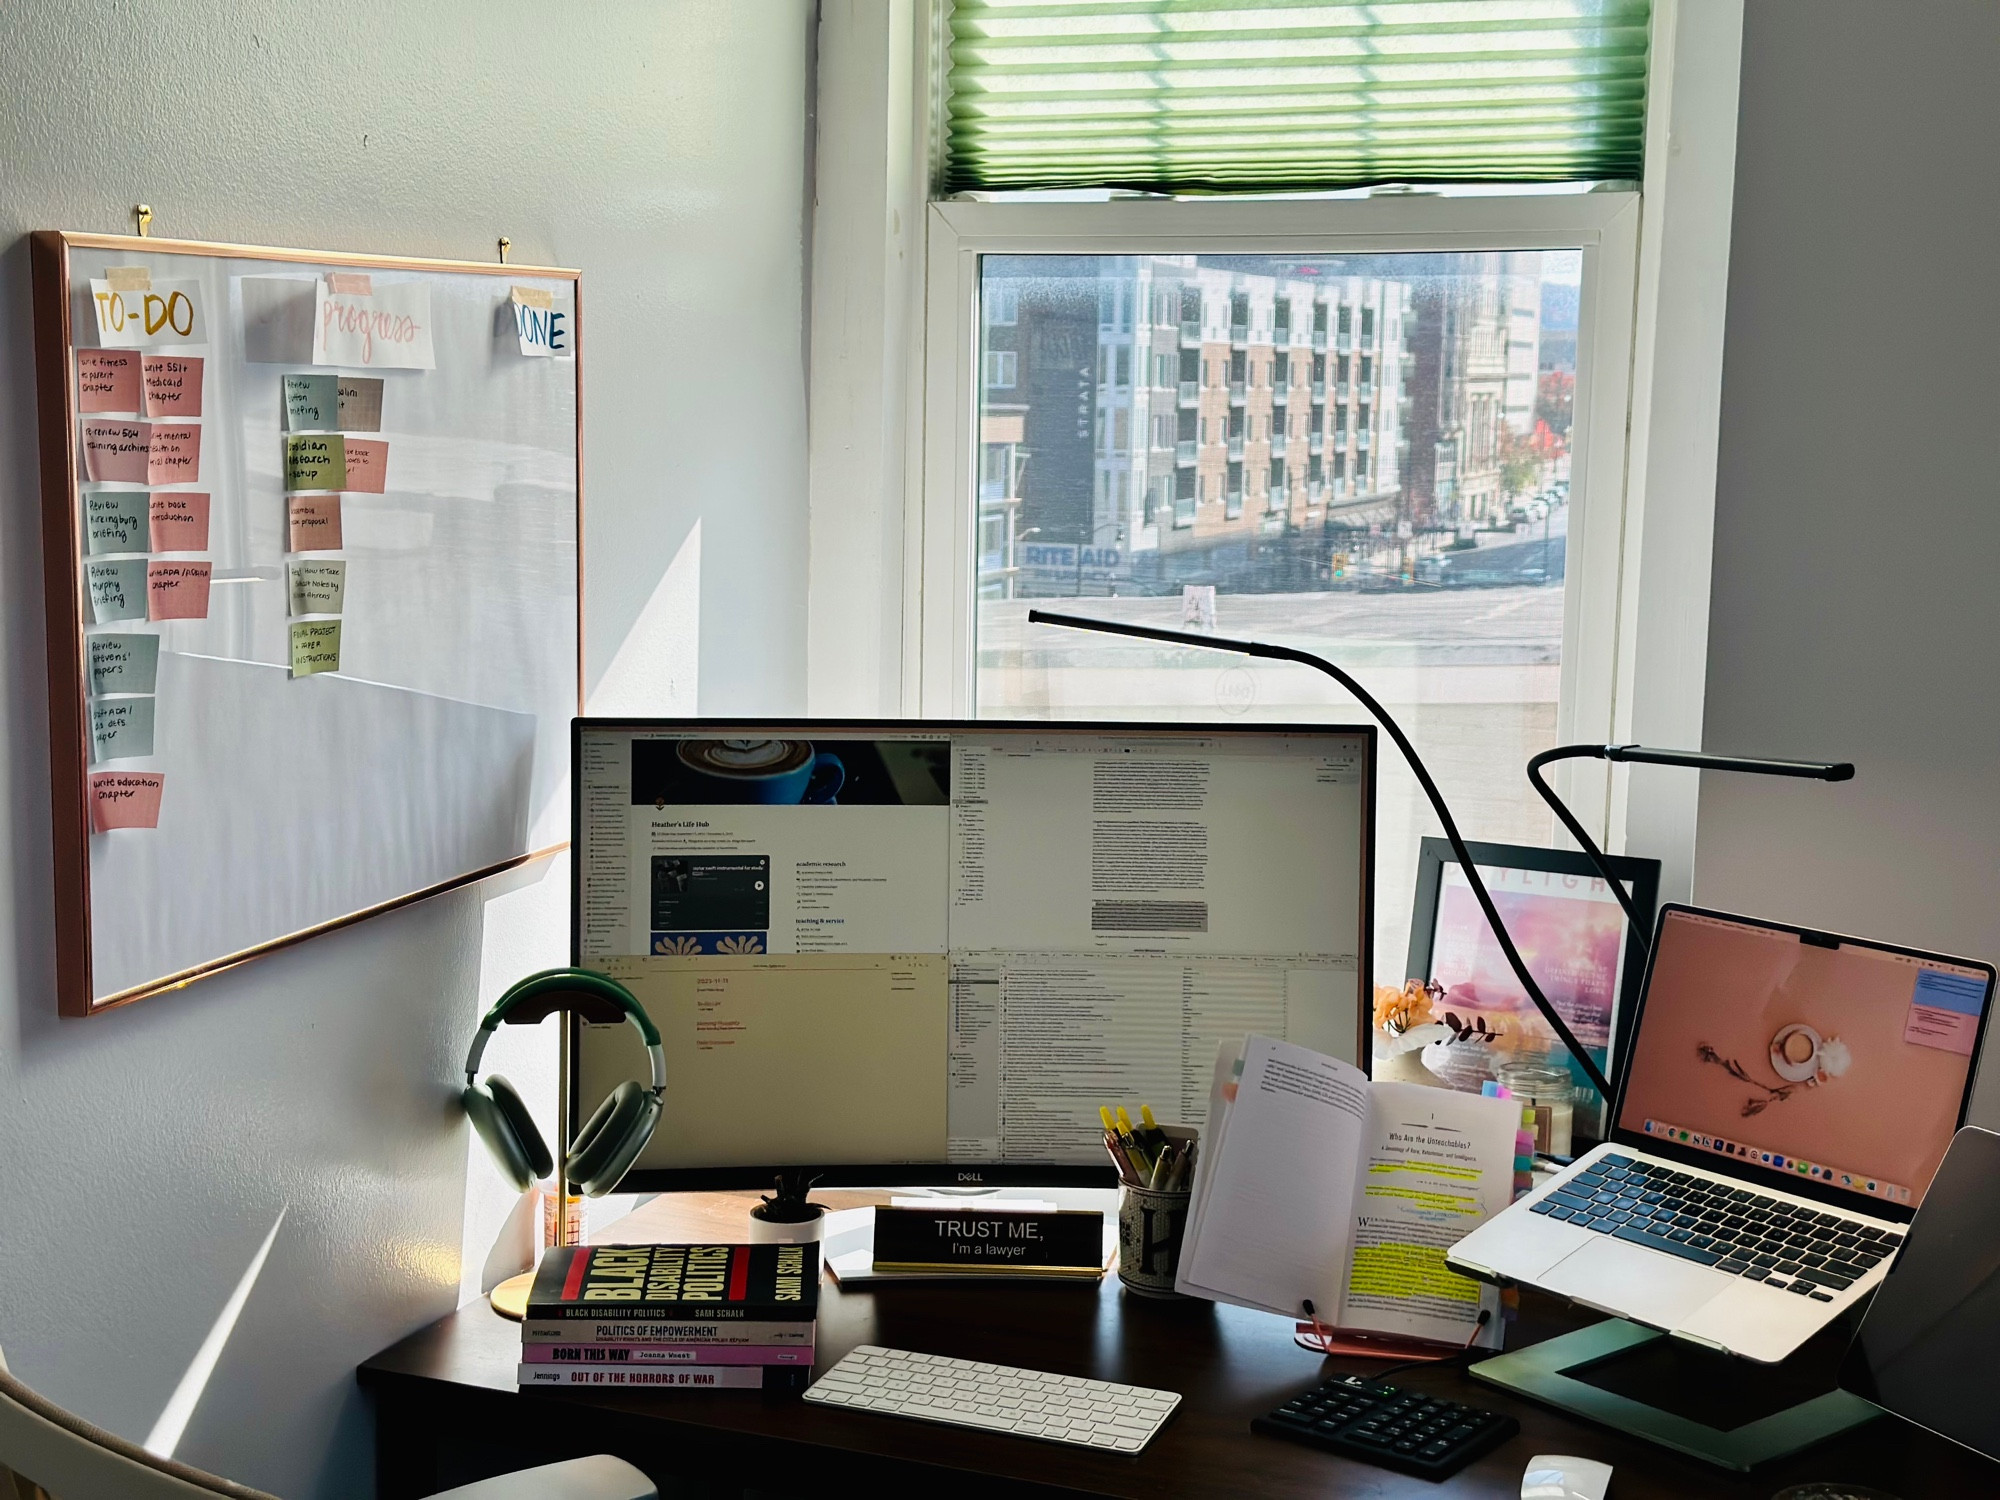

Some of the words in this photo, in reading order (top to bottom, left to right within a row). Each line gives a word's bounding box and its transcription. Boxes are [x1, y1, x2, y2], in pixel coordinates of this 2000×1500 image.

[95, 291, 194, 336] TO-DO
[1077, 367, 1091, 439] STRATA
[122, 428, 139, 438] 504
[1026, 546, 1076, 566] RITE
[1081, 546, 1120, 567] AID
[1389, 1132, 1402, 1141] Who
[1404, 1134, 1414, 1142] Are
[1415, 1136, 1425, 1144] the
[1427, 1137, 1471, 1150] Unteachables?
[958, 1173, 983, 1182] DELL
[935, 1220, 1003, 1238] TRUST
[1008, 1222, 1044, 1242] ME,
[953, 1243, 970, 1254] I'm
[974, 1246, 982, 1255] a
[986, 1243, 1027, 1258] lawyer
[776, 1247, 804, 1275] SCHALK
[584, 1247, 652, 1300] BLACK
[645, 1247, 686, 1300] DISABILITY
[682, 1247, 729, 1300] POLITICS
[775, 1276, 802, 1301] SAMI
[566, 1309, 589, 1317] BLACK
[591, 1309, 632, 1318] DISABILITY
[633, 1309, 666, 1318] POLITICS
[695, 1309, 714, 1318] SAMI
[717, 1309, 744, 1318] SCHALK
[596, 1326, 635, 1336] POLITICS
[637, 1326, 649, 1336] OF
[650, 1326, 718, 1337] EMPOWERMENT
[552, 1348, 581, 1360] BORN
[583, 1349, 606, 1360] THIS
[608, 1349, 630, 1361] WAY
[533, 1372, 560, 1382] Jennings
[571, 1372, 591, 1382] OUT
[593, 1372, 605, 1382] OF
[608, 1373, 626, 1383] THE
[630, 1373, 675, 1384] HORRORS
[678, 1374, 690, 1384] OF
[693, 1374, 715, 1384] WAR
